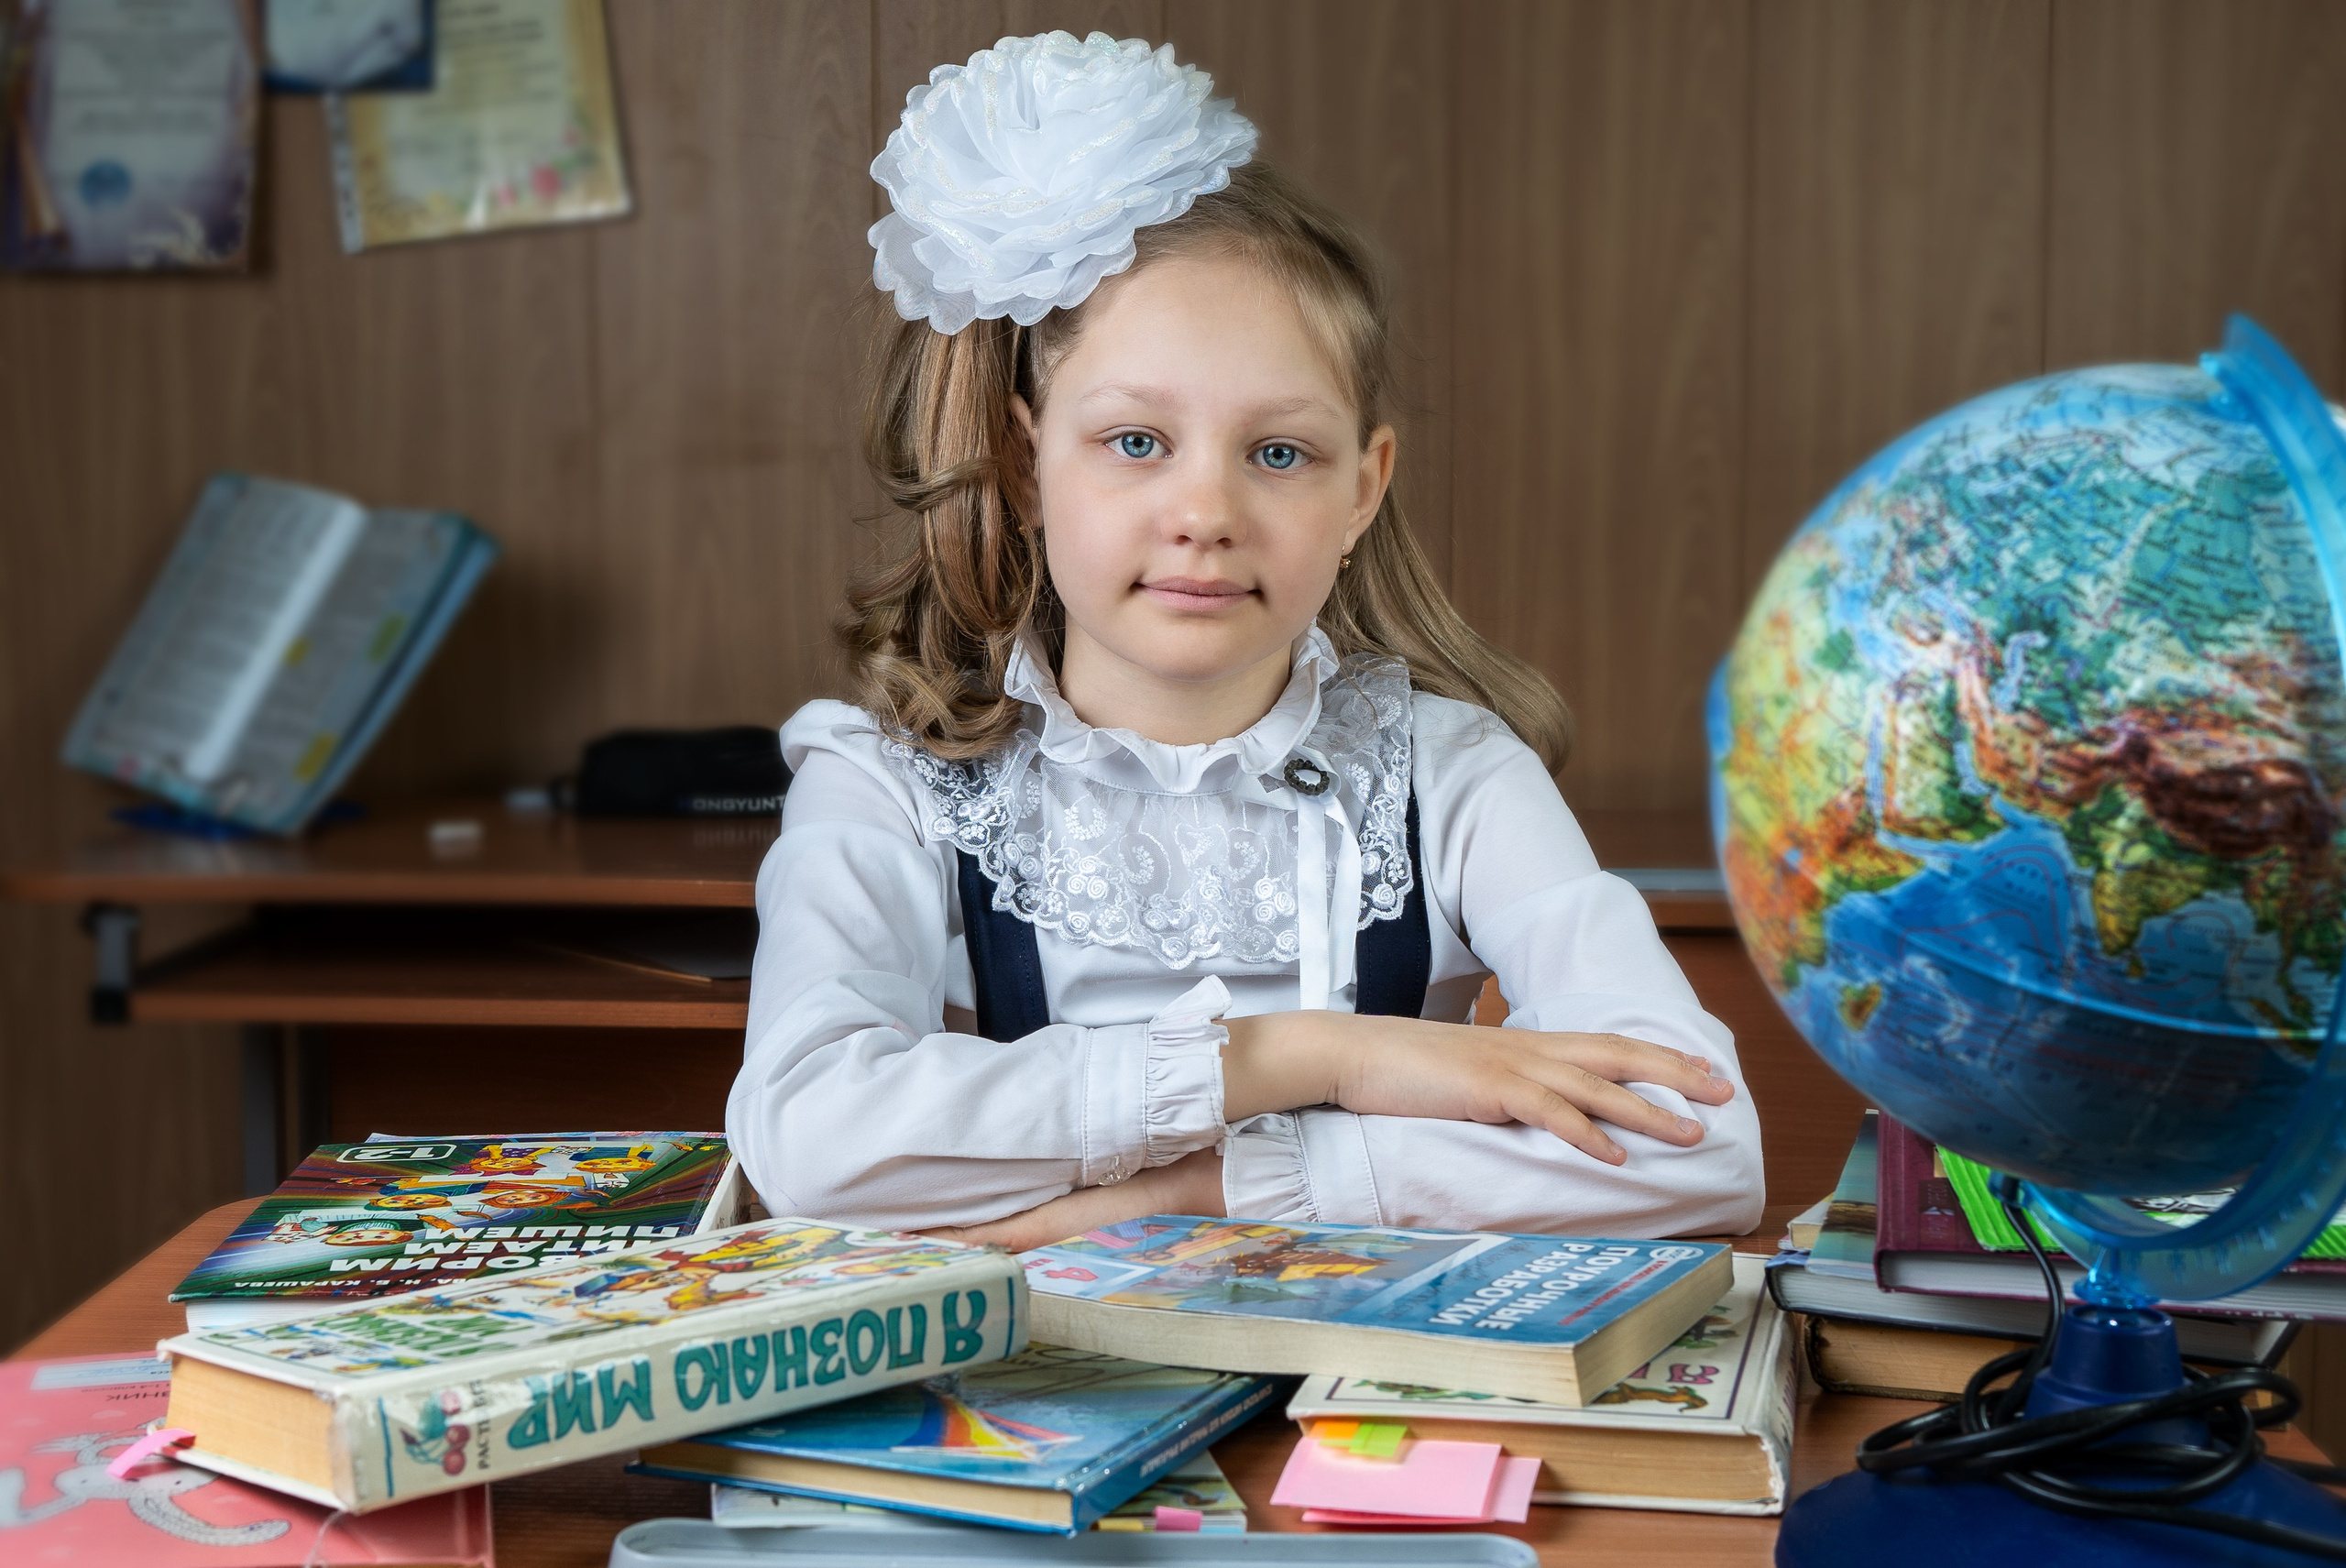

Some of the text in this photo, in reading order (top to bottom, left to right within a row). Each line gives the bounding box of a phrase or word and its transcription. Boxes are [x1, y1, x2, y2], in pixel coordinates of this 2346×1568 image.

[357, 1146, 437, 1161] 1-2
[423, 1225, 680, 1239] ПИШЕМ
[328, 1255, 582, 1272] ВОРИМ
[1024, 1258, 1055, 1270] КЛА
[1040, 1266, 1099, 1282] 4
[234, 1279, 360, 1288] КАРАШЕВА
[1428, 1241, 1595, 1326] РАЗРАБОТКИ
[1474, 1243, 1639, 1330] ПОУРОЧНЫЕ
[504, 1288, 987, 1452] Я ПОЗНАЮ МИР
